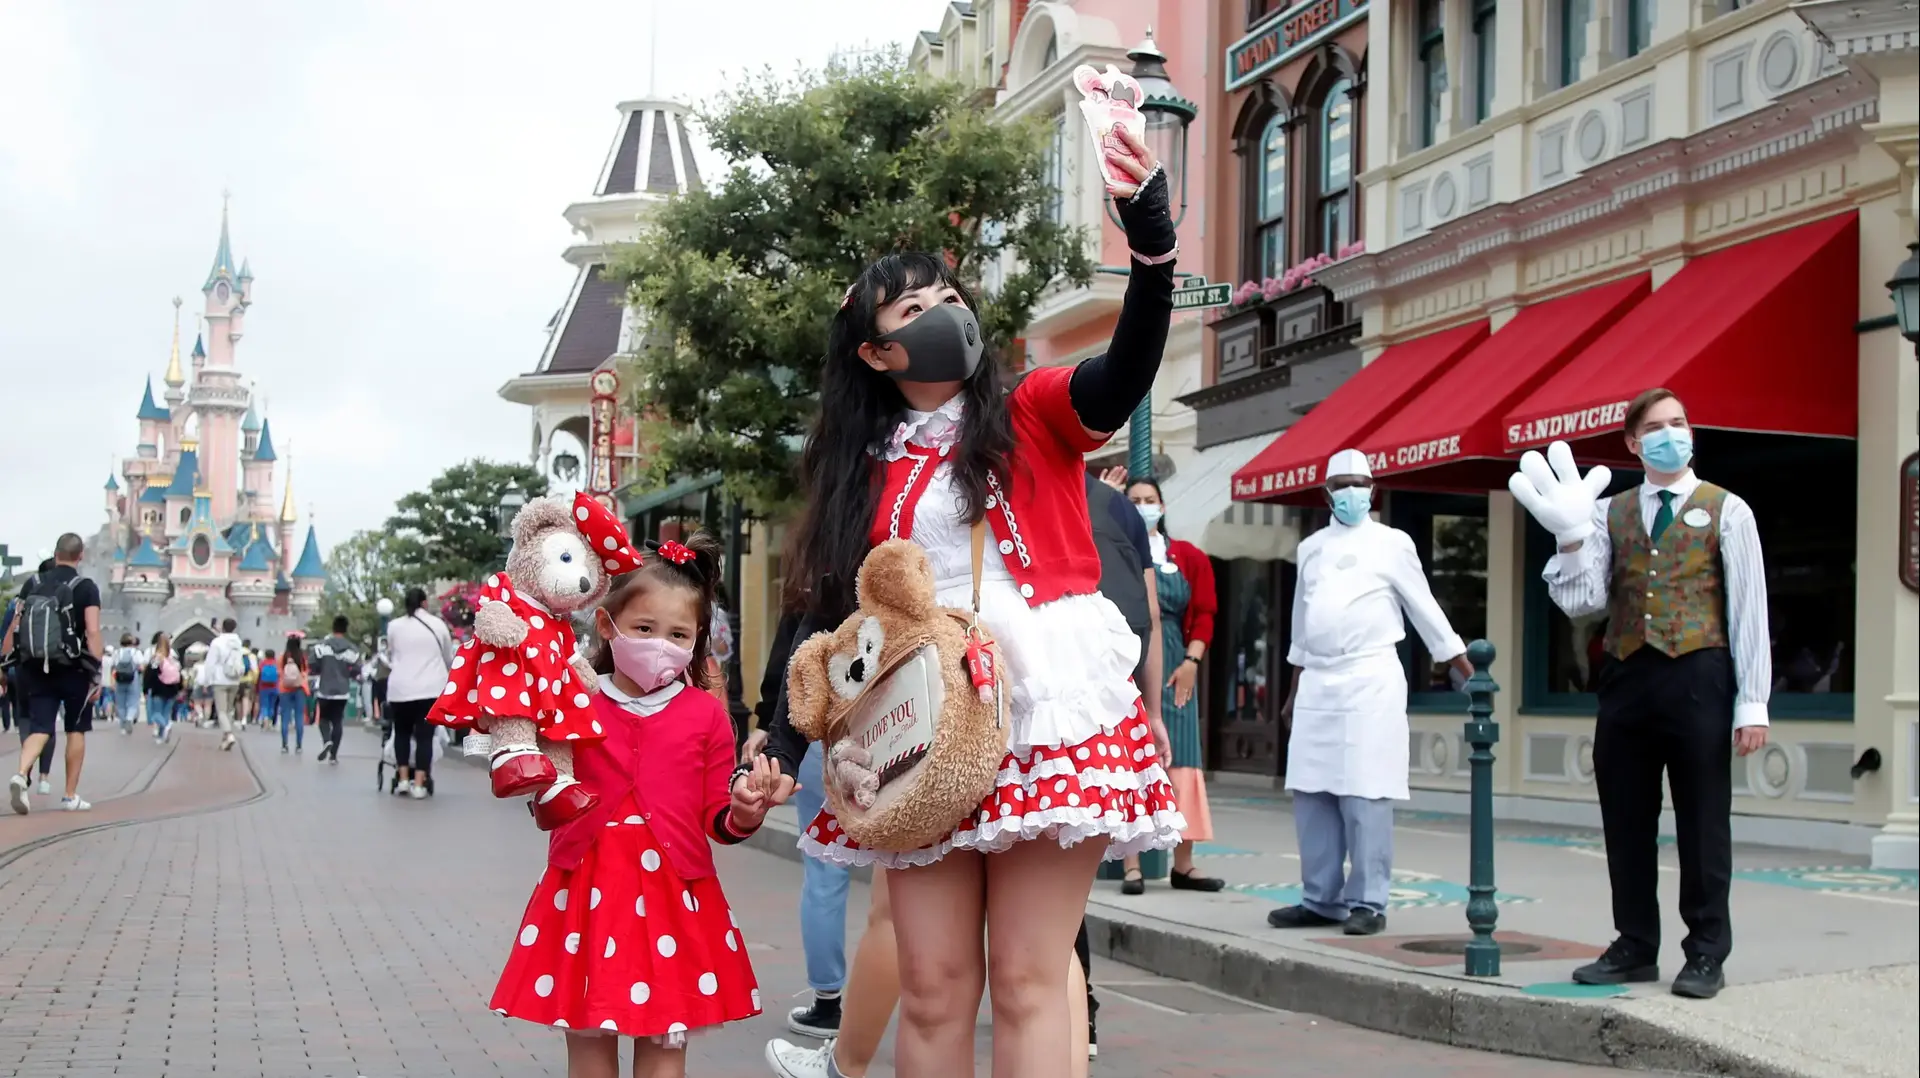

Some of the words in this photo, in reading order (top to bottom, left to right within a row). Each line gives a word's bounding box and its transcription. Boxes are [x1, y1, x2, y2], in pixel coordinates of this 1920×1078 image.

[1238, 31, 1278, 74] MAIN
[1284, 0, 1340, 47] STREET
[1174, 290, 1205, 307] ARKET
[1208, 288, 1222, 303] ST.
[1508, 400, 1629, 444] SANDWICHE
[1368, 453, 1388, 471] EA
[1397, 435, 1460, 465] COFFEE
[1261, 465, 1317, 492] MEATS
[866, 714, 889, 748] LOVE
[890, 698, 914, 728] YOU
